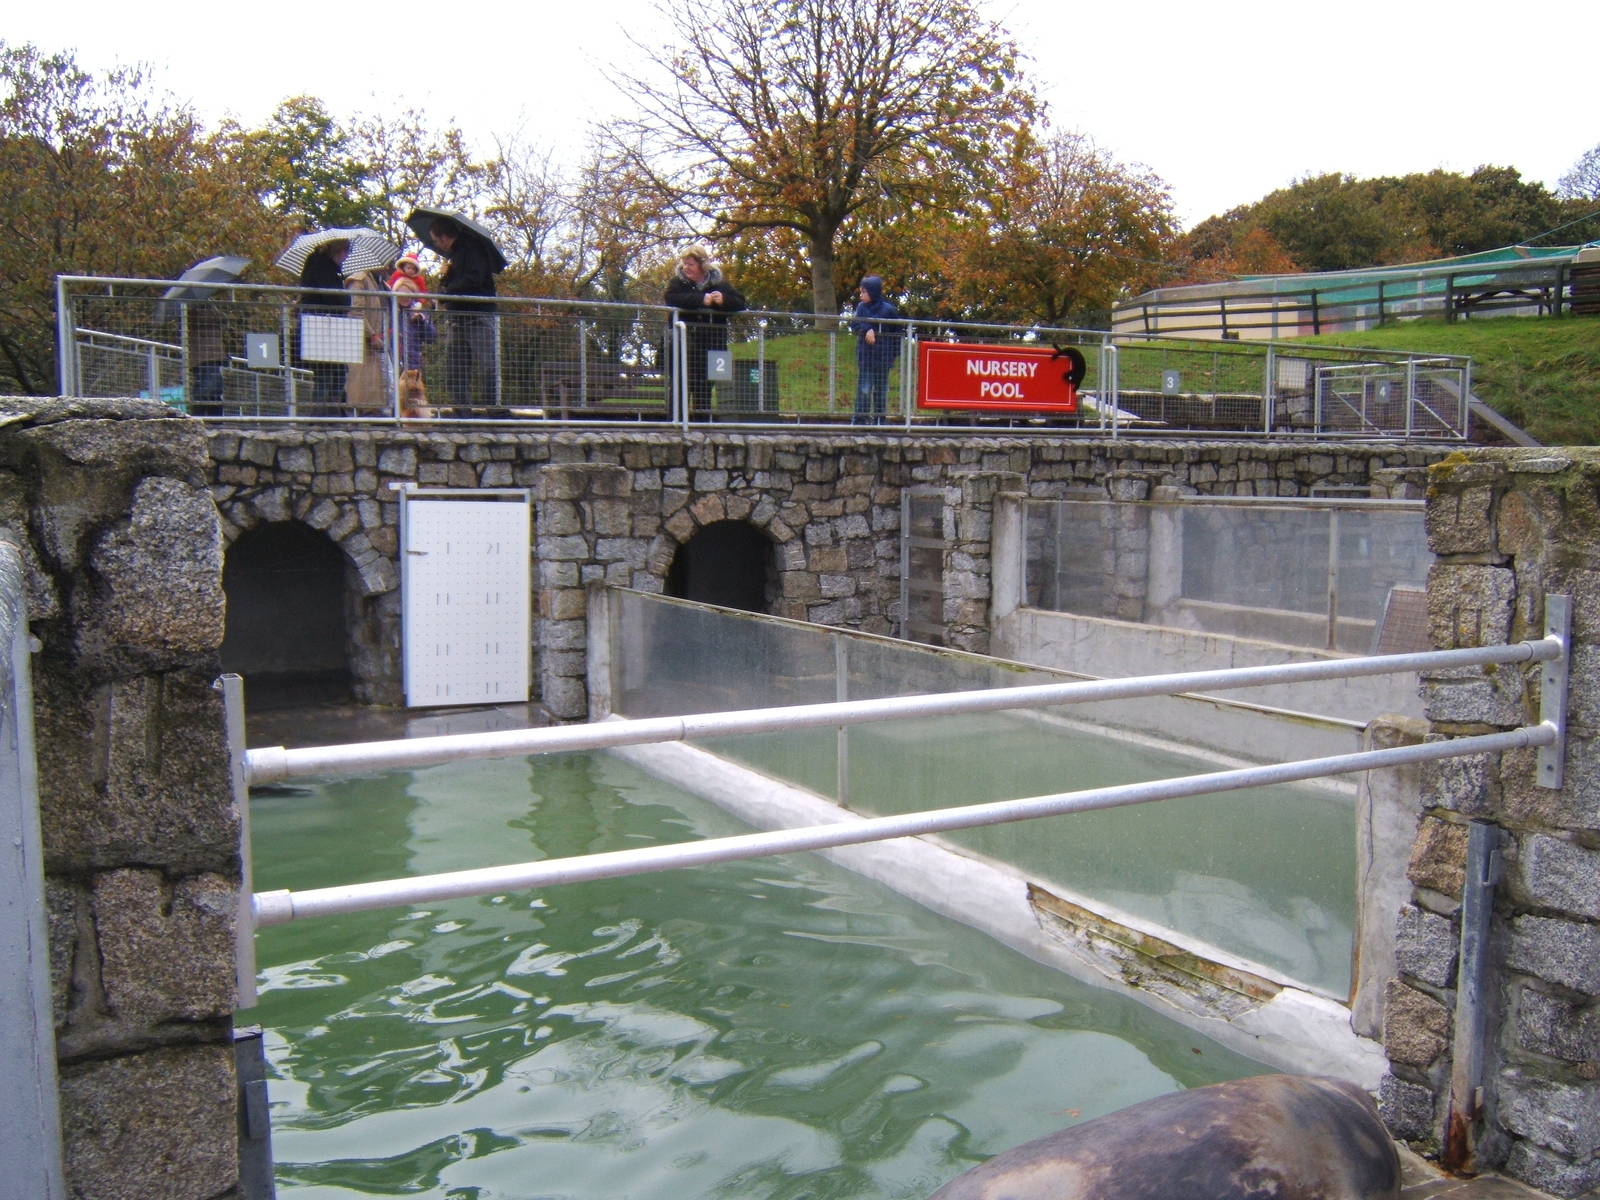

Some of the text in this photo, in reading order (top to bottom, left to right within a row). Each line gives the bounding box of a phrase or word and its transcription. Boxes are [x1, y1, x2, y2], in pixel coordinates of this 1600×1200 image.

[259, 343, 267, 358] 1
[715, 358, 725, 371] 2
[966, 359, 1038, 377] NURSERY
[980, 381, 1024, 398] POOL
[1167, 376, 1174, 388] 3
